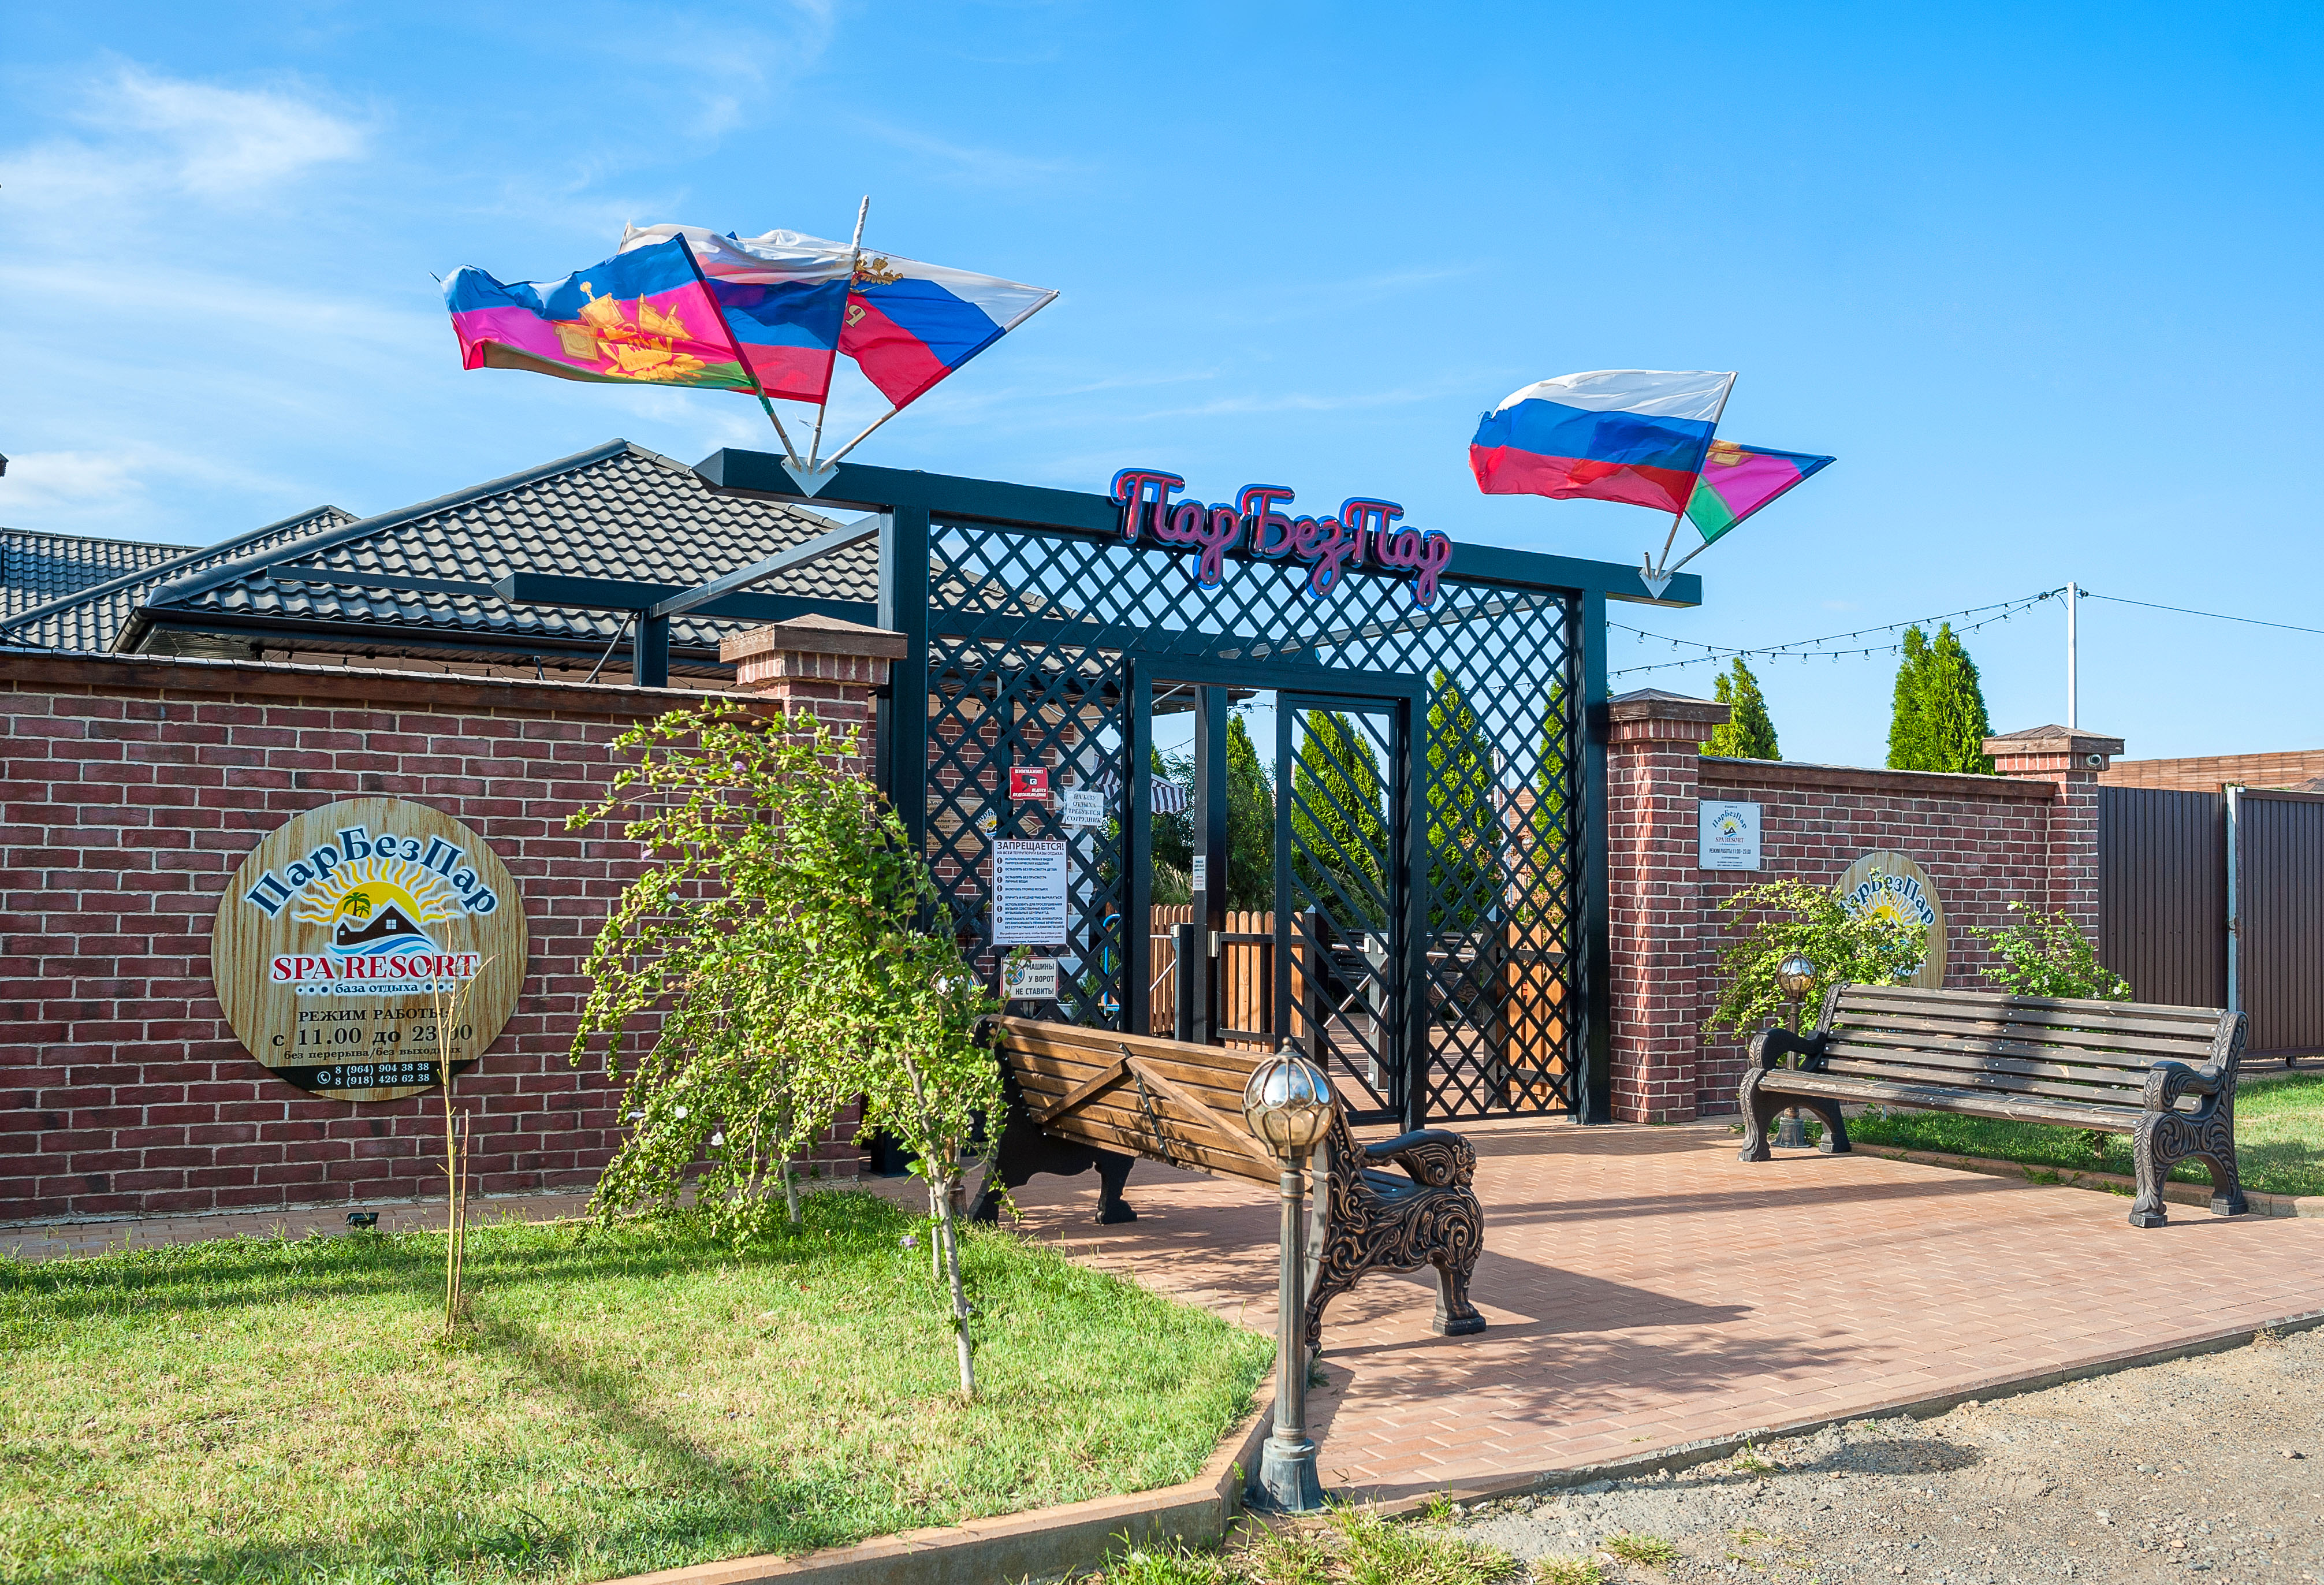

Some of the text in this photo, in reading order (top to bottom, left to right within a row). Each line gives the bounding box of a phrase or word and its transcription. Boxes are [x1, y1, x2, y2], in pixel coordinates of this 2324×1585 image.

[1712, 809, 1746, 829] ПарБезПар
[997, 842, 1064, 851] ЗАПРЕЩАЕТСЯ!
[247, 828, 497, 917] ПарБезПар
[273, 955, 478, 980] SPA RESORT
[335, 983, 418, 993] база отдыха
[298, 1010, 367, 1022] РЕЖИМ
[272, 1024, 472, 1046] с 11.00 до 2300
[284, 1051, 303, 1059] без
[308, 1047, 394, 1060] перерыва/без
[347, 1065, 374, 1076] (964)
[378, 1064, 397, 1072] 904
[347, 1076, 374, 1088] (918)
